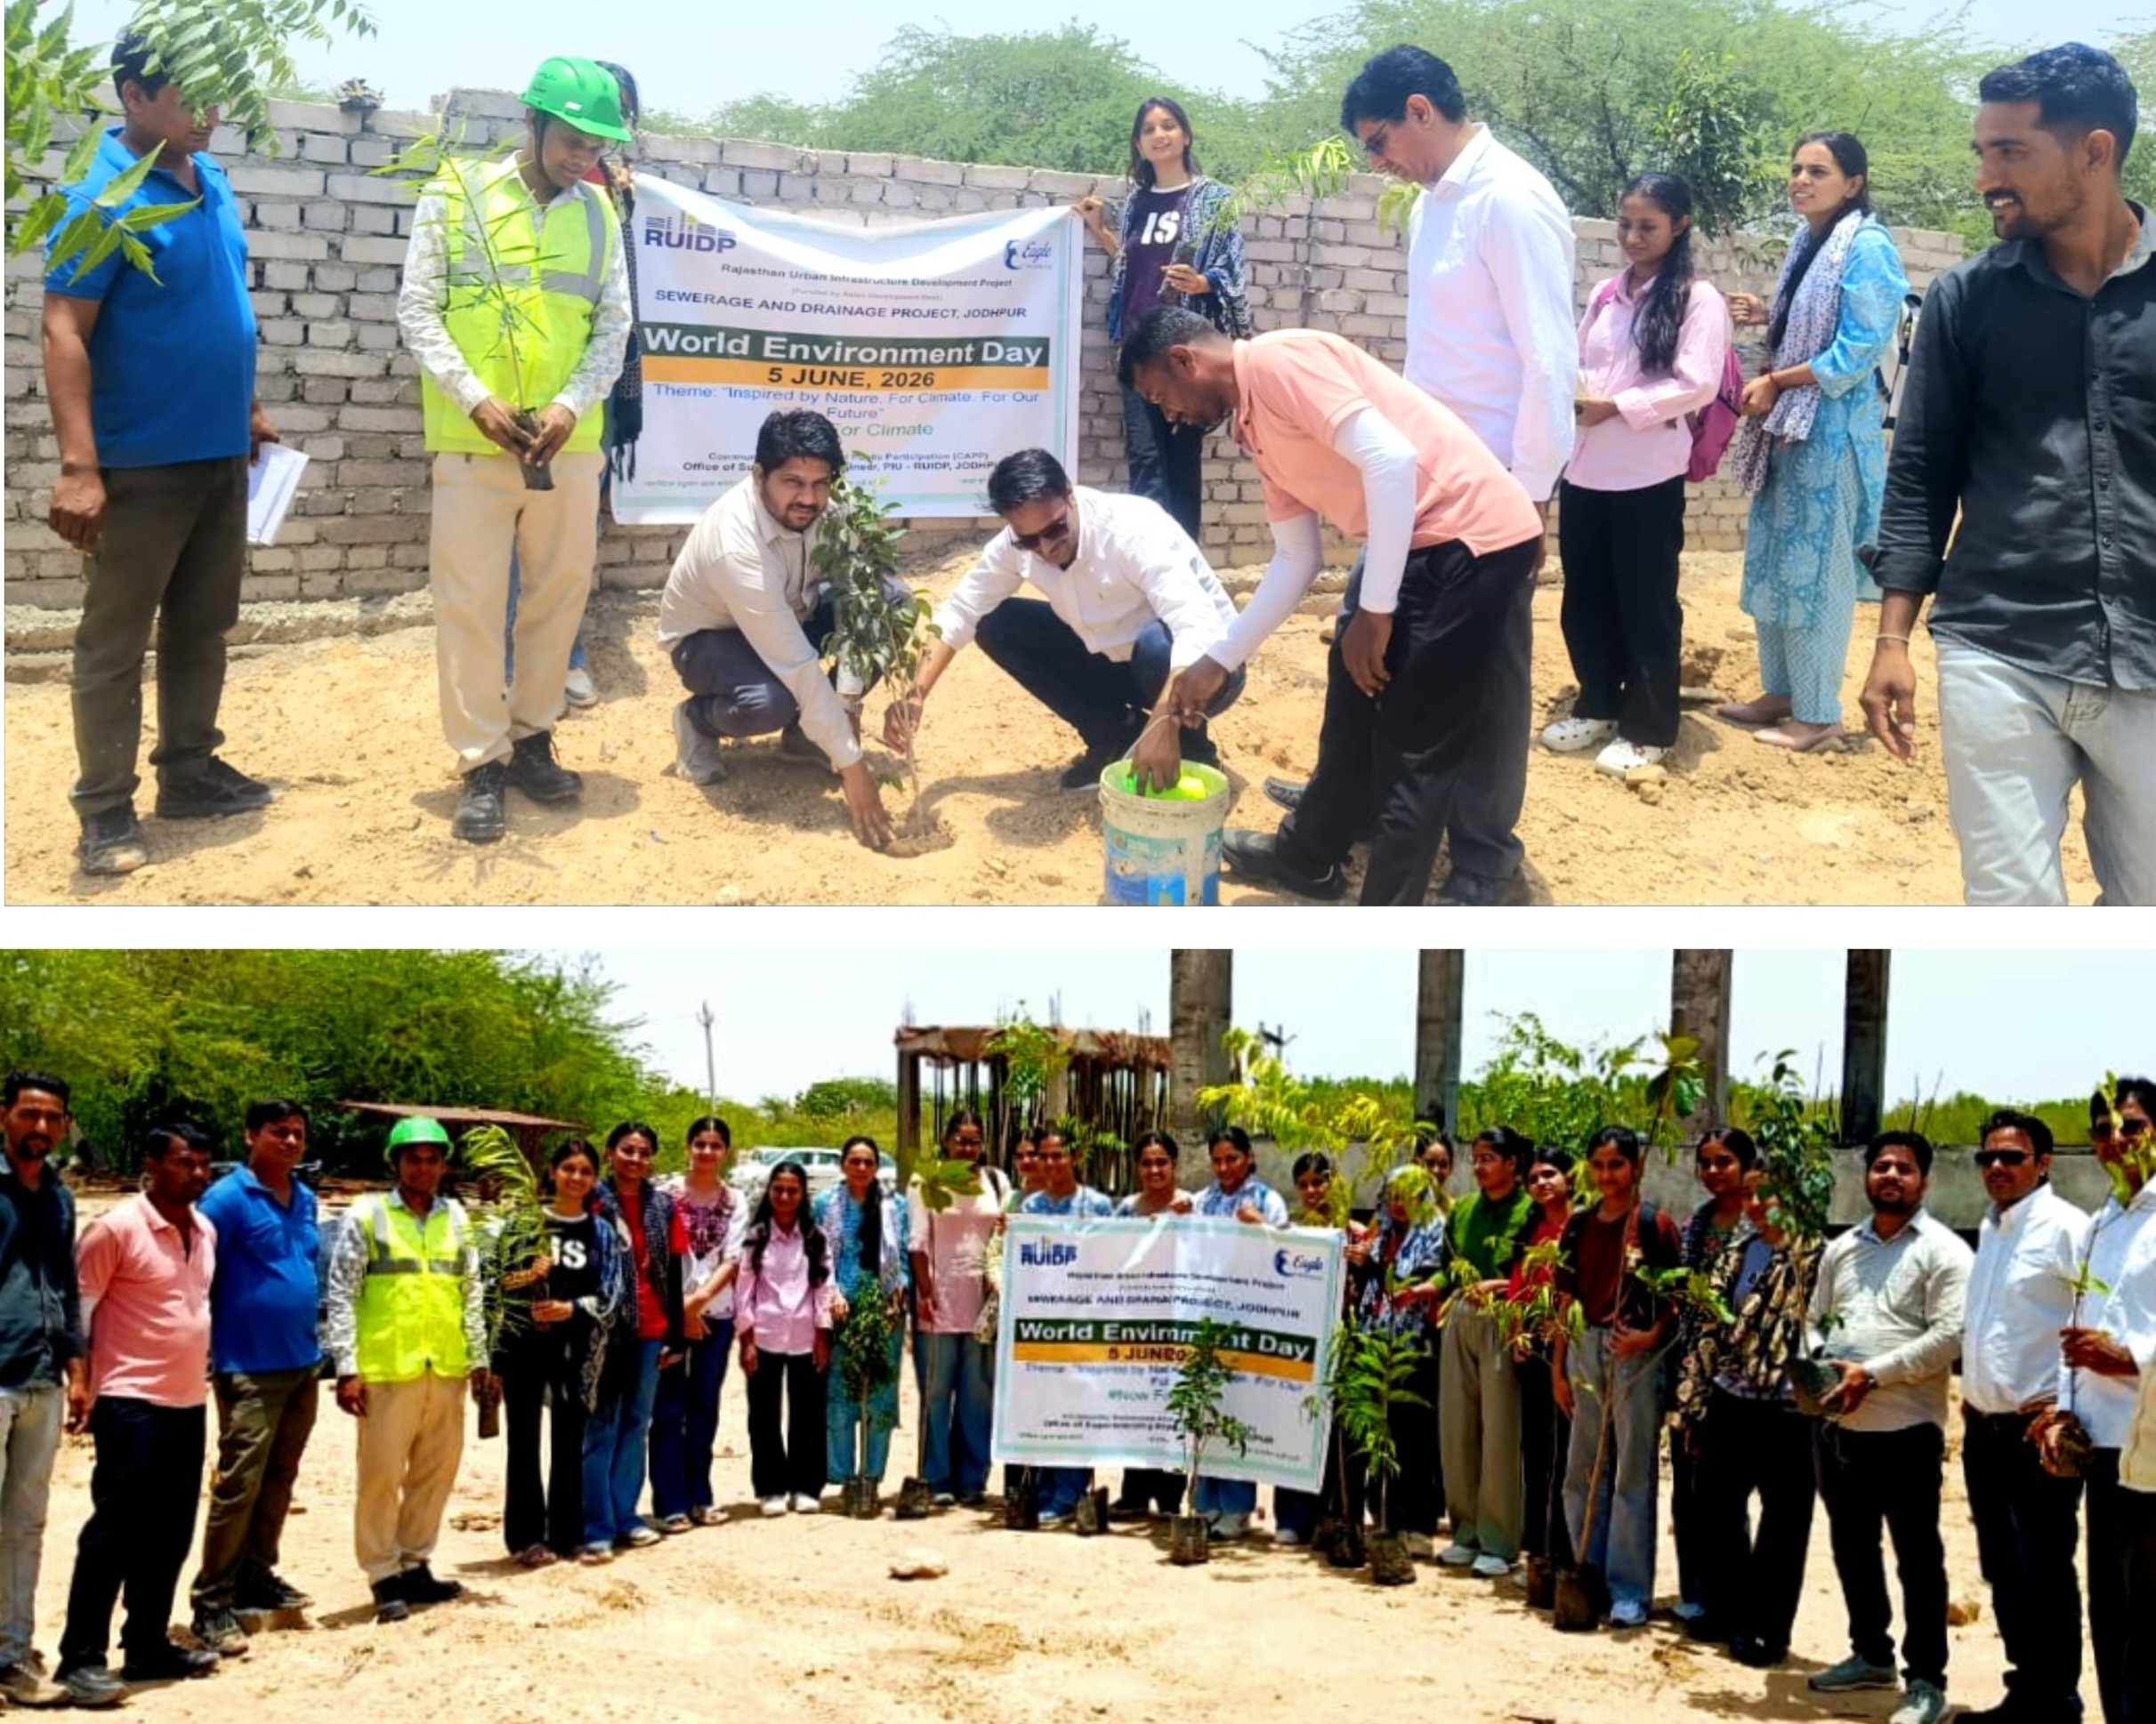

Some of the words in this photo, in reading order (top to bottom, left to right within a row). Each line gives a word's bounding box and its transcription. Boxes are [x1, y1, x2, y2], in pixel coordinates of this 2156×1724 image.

[645, 229, 737, 254] RUIDP
[1021, 240, 1052, 263] Eagle
[722, 263, 786, 278] Rajasthan
[789, 270, 828, 282] Urban
[830, 273, 909, 286] Infrastructure
[911, 277, 978, 288] Development
[980, 278, 1013, 288] Project
[655, 289, 754, 309] SEWERAGE
[758, 299, 796, 312] AND
[801, 302, 887, 318] DRAINAGE
[891, 308, 959, 320] PROJECT,
[964, 308, 1027, 318] JODHPUR
[643, 326, 751, 356] World
[763, 335, 975, 365] Environment
[981, 341, 1043, 367] Day
[768, 367, 783, 383] 5
[791, 368, 871, 389] JUNE,
[881, 371, 935, 388] 2026
[653, 383, 718, 398] Theme:
[800, 390, 820, 405] by
[825, 392, 882, 405] Nature.
[889, 392, 913, 404] For
[918, 391, 974, 404] Climate.
[981, 391, 1010, 402] For
[1013, 391, 1039, 403] Our
[867, 423, 933, 437] Climate
[682, 462, 719, 471] Office
[723, 462, 735, 471] of
[955, 461, 996, 470] JODHP
[1019, 1322, 1094, 1341] World
[1257, 1333, 1311, 1362] Day
[1108, 1347, 1119, 1360] 5
